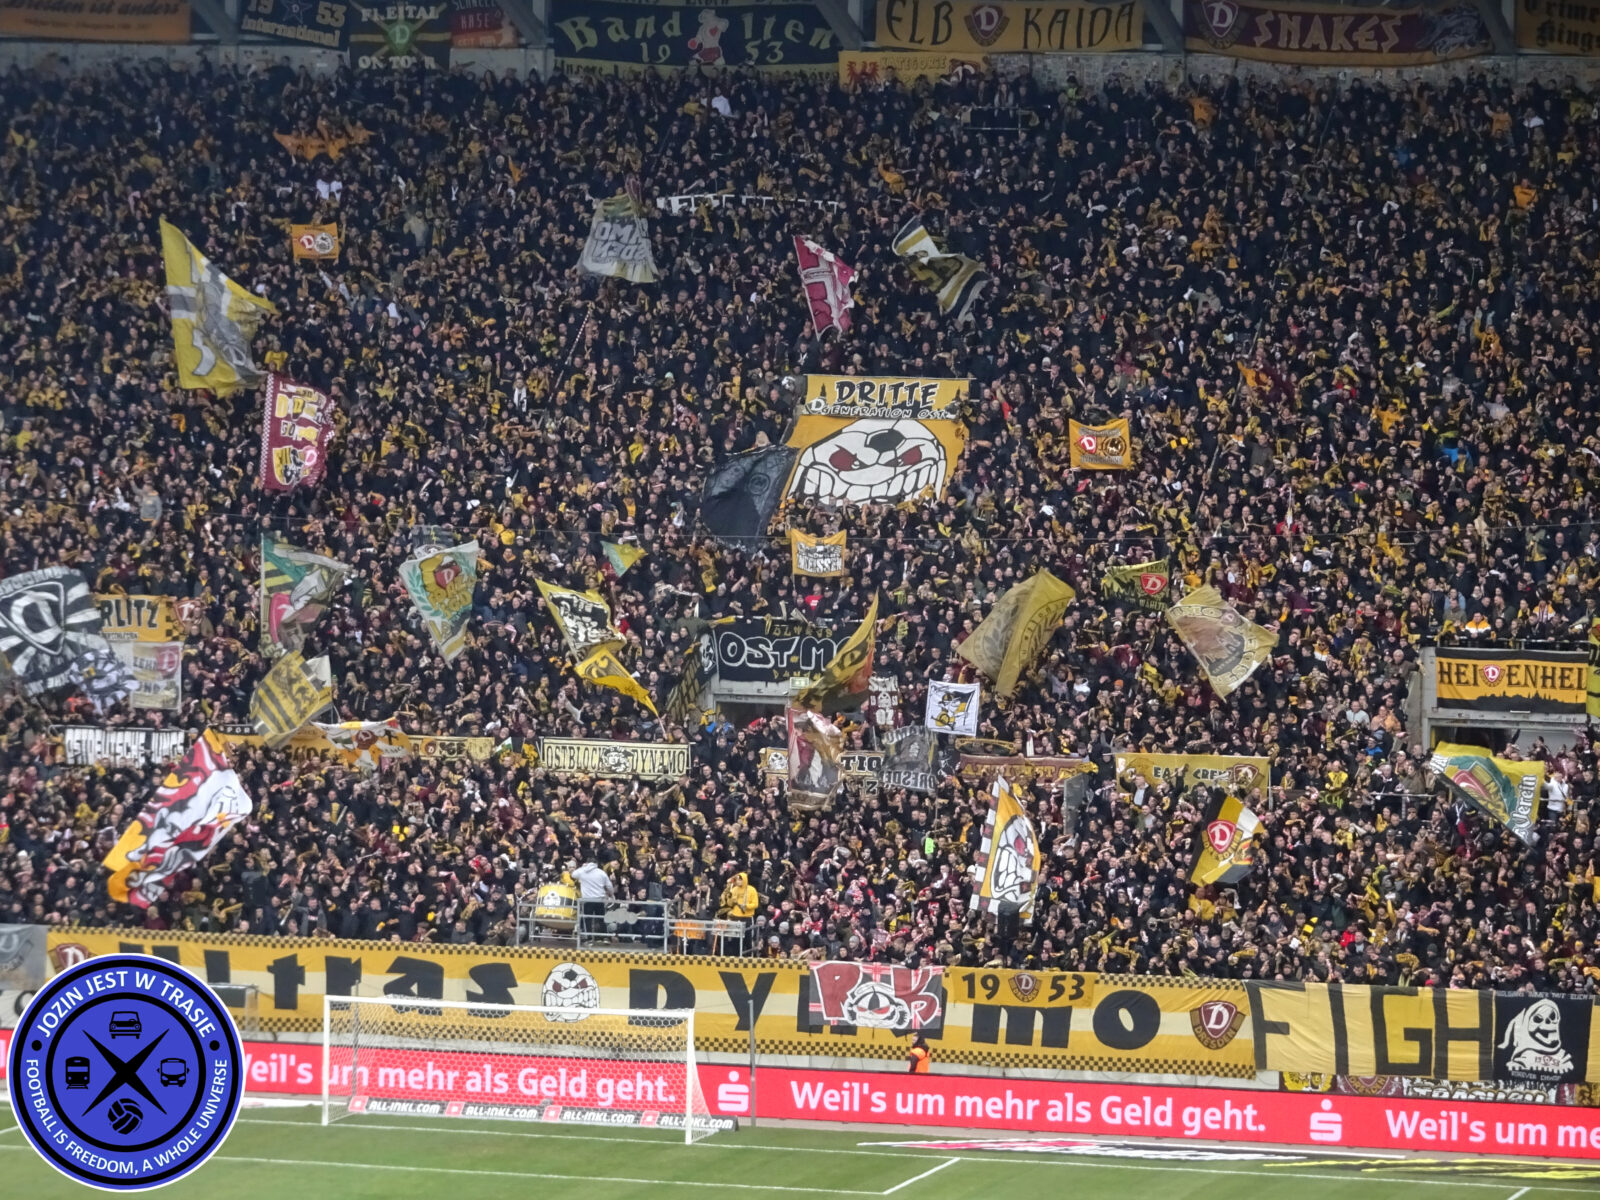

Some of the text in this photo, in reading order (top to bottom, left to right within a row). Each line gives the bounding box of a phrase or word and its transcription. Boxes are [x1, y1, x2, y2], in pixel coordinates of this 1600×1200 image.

[316, 1, 347, 28] 53
[887, 0, 954, 46] ELB
[1023, 0, 1137, 49] KAIDA
[1253, 10, 1402, 54] SNAKES
[822, 404, 913, 419] GENERATION
[835, 379, 939, 409] DRITTE
[718, 631, 801, 670] OST
[545, 745, 687, 774] OSTBLOCK DYNAMO
[961, 972, 1000, 1000] 19
[1047, 973, 1086, 1002] 53
[326, 1062, 370, 1089] um
[377, 1062, 461, 1092] mehr
[465, 1062, 510, 1095] als
[517, 1066, 588, 1099] Geld
[596, 1069, 677, 1106] geht.
[790, 1080, 1267, 1136] Weil's um mehr als Geld geht.
[1384, 1109, 1486, 1143] Weil's
[1494, 1121, 1547, 1146] um
